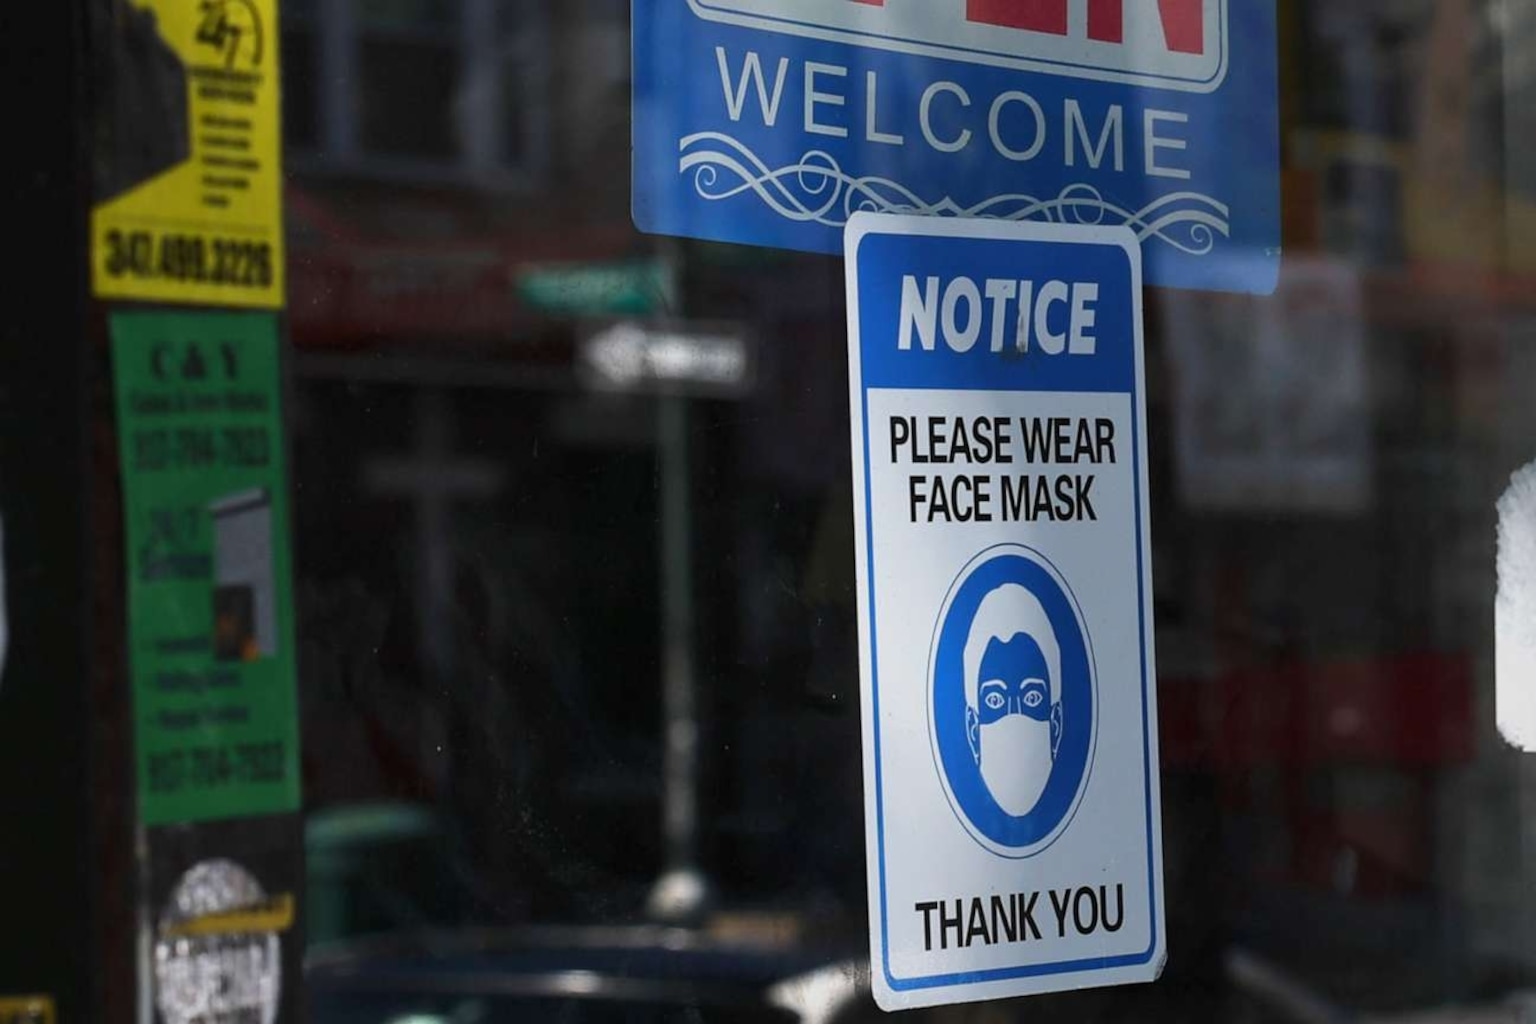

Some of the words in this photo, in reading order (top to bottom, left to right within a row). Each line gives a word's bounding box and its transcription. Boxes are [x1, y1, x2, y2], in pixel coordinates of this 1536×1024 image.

[714, 46, 1192, 180] WELCOME
[898, 275, 1099, 355] NOTICE
[889, 416, 1012, 464] PLEASE
[1020, 417, 1116, 464] WEAR
[909, 475, 992, 523] FACE
[1001, 475, 1097, 521] MASK
[915, 891, 1042, 951] THANK
[1048, 883, 1124, 937] YOU
